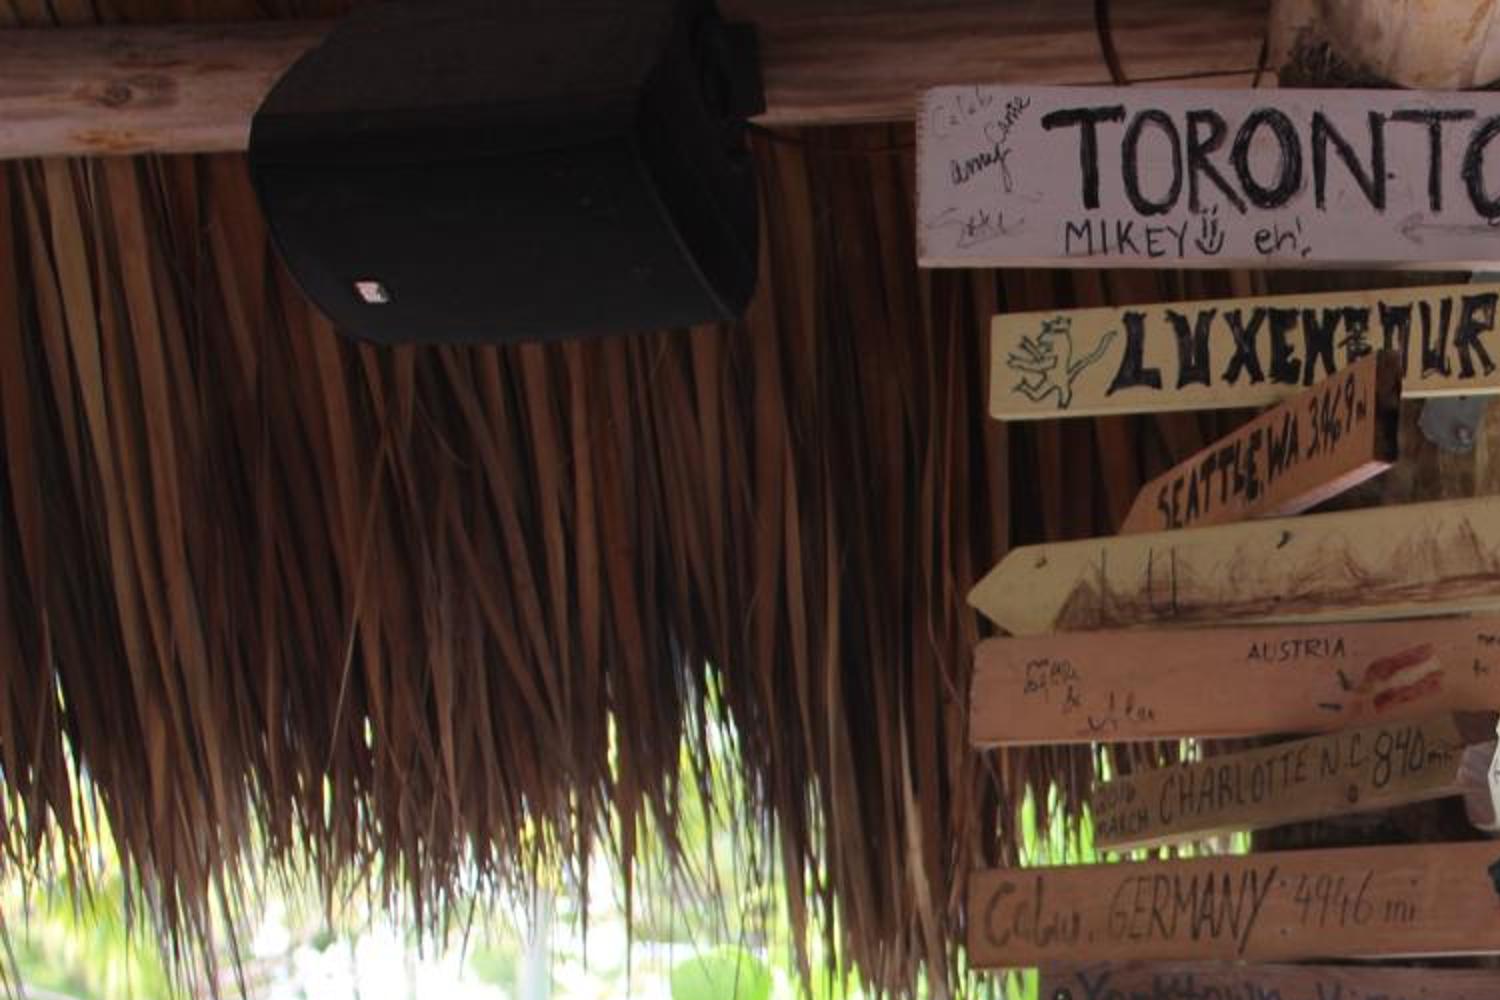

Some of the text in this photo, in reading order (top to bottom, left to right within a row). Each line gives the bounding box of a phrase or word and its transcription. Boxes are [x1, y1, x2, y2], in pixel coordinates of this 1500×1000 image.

[1064, 218, 1187, 256] MIKEY
[1247, 636, 1345, 663] AUSTRIA
[1159, 750, 1307, 827] CHARLOTTE
[1105, 865, 1278, 957] GERMANY
